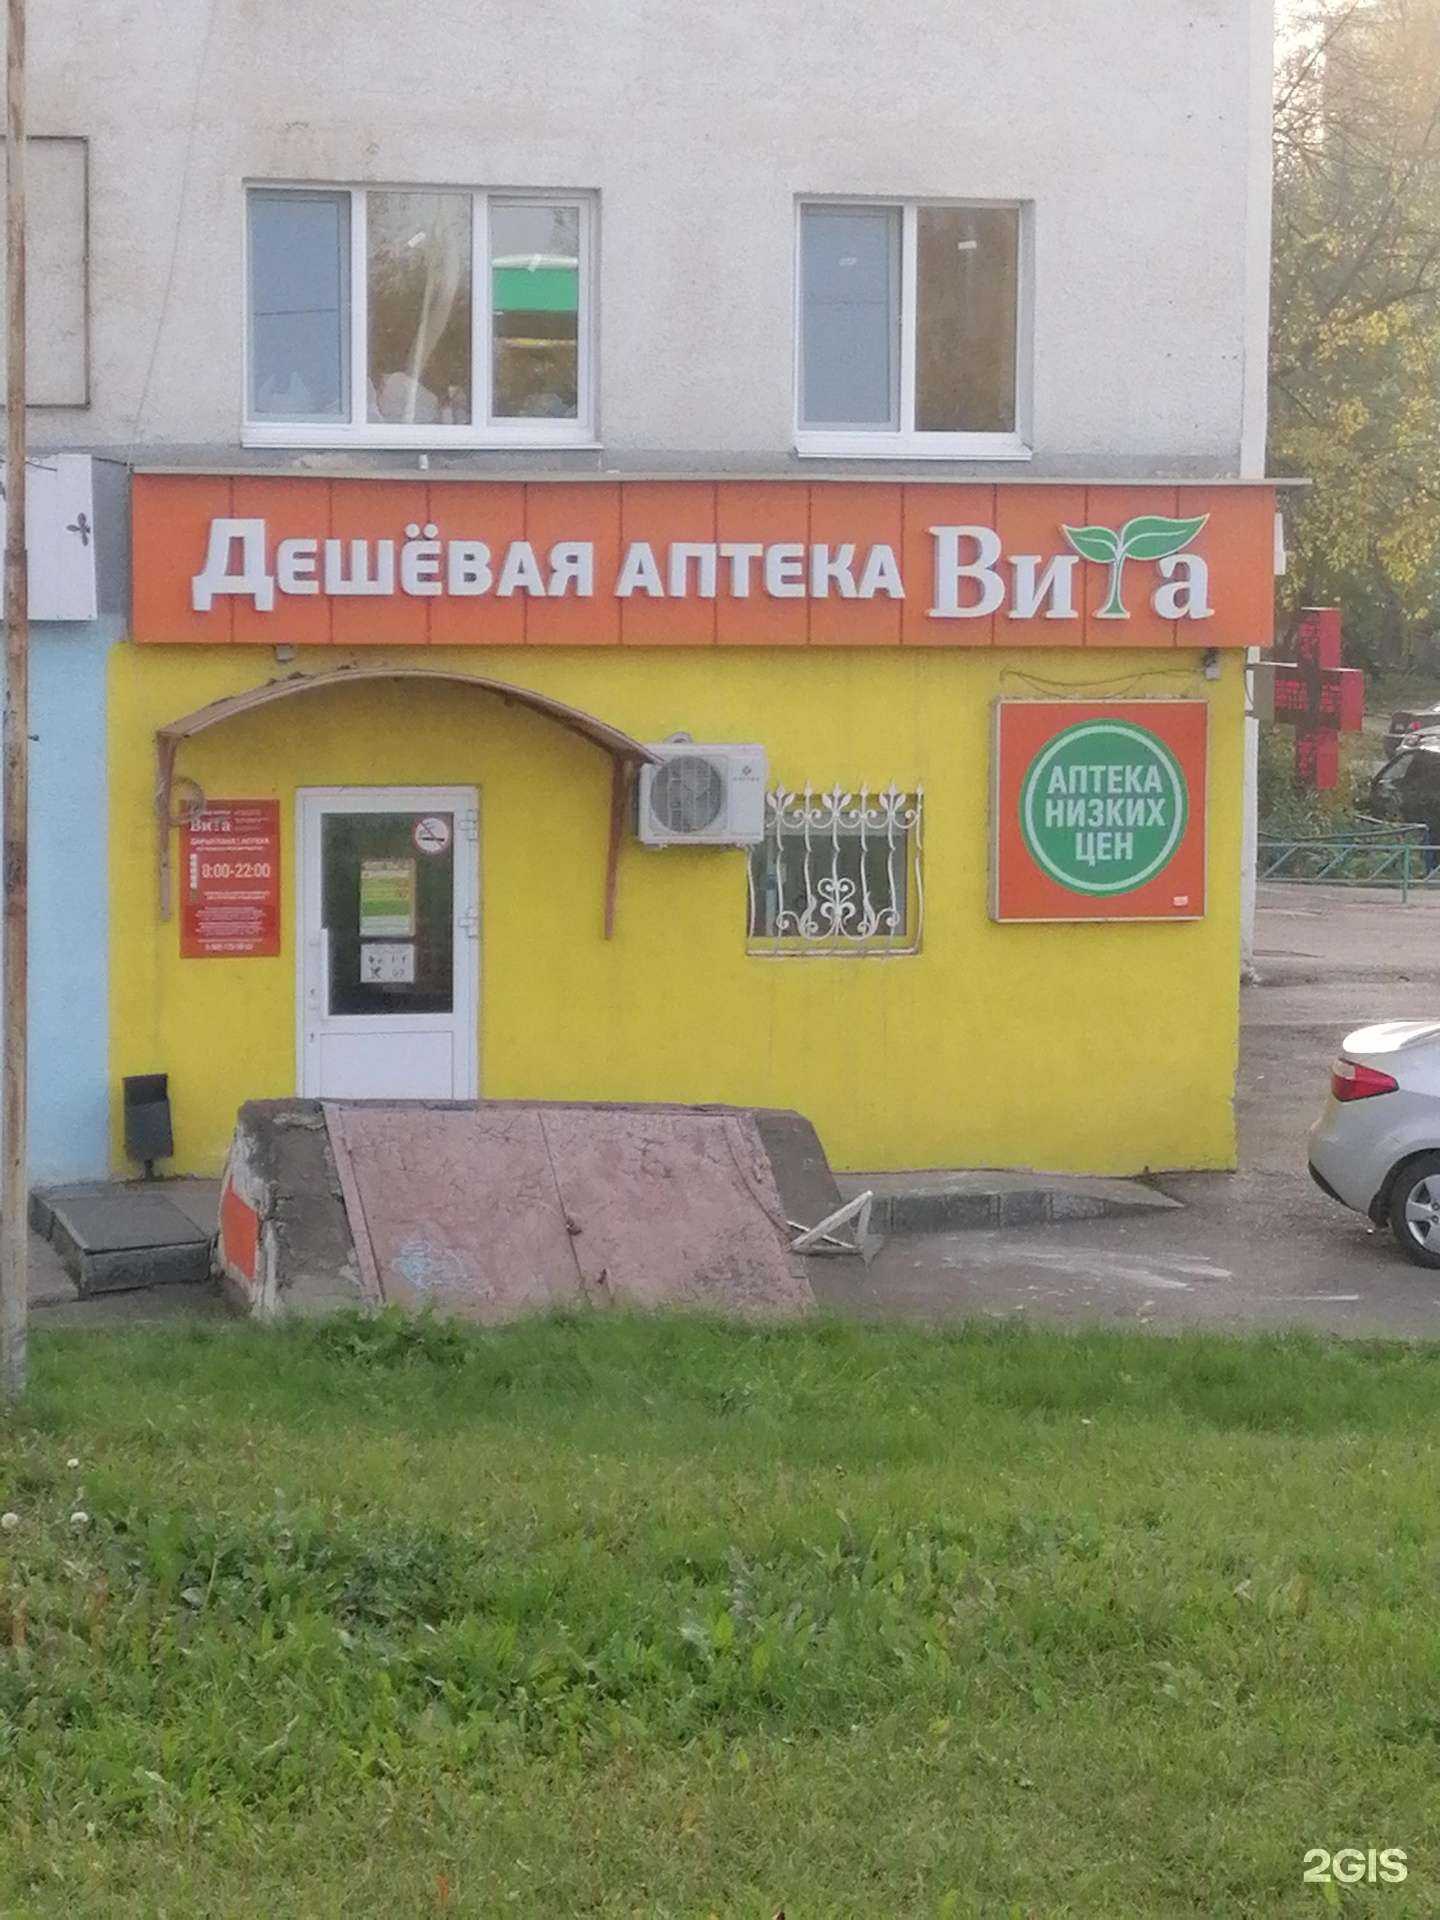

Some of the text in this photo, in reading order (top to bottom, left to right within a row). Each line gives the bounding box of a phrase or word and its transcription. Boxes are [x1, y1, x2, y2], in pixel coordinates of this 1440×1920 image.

[615, 541, 906, 600] АПТЕКА
[927, 513, 1216, 621] Вита
[1046, 765, 1163, 795] АПТЕКА
[1045, 798, 1167, 828] НИЗКИХ
[1075, 831, 1134, 868] ЦЕН
